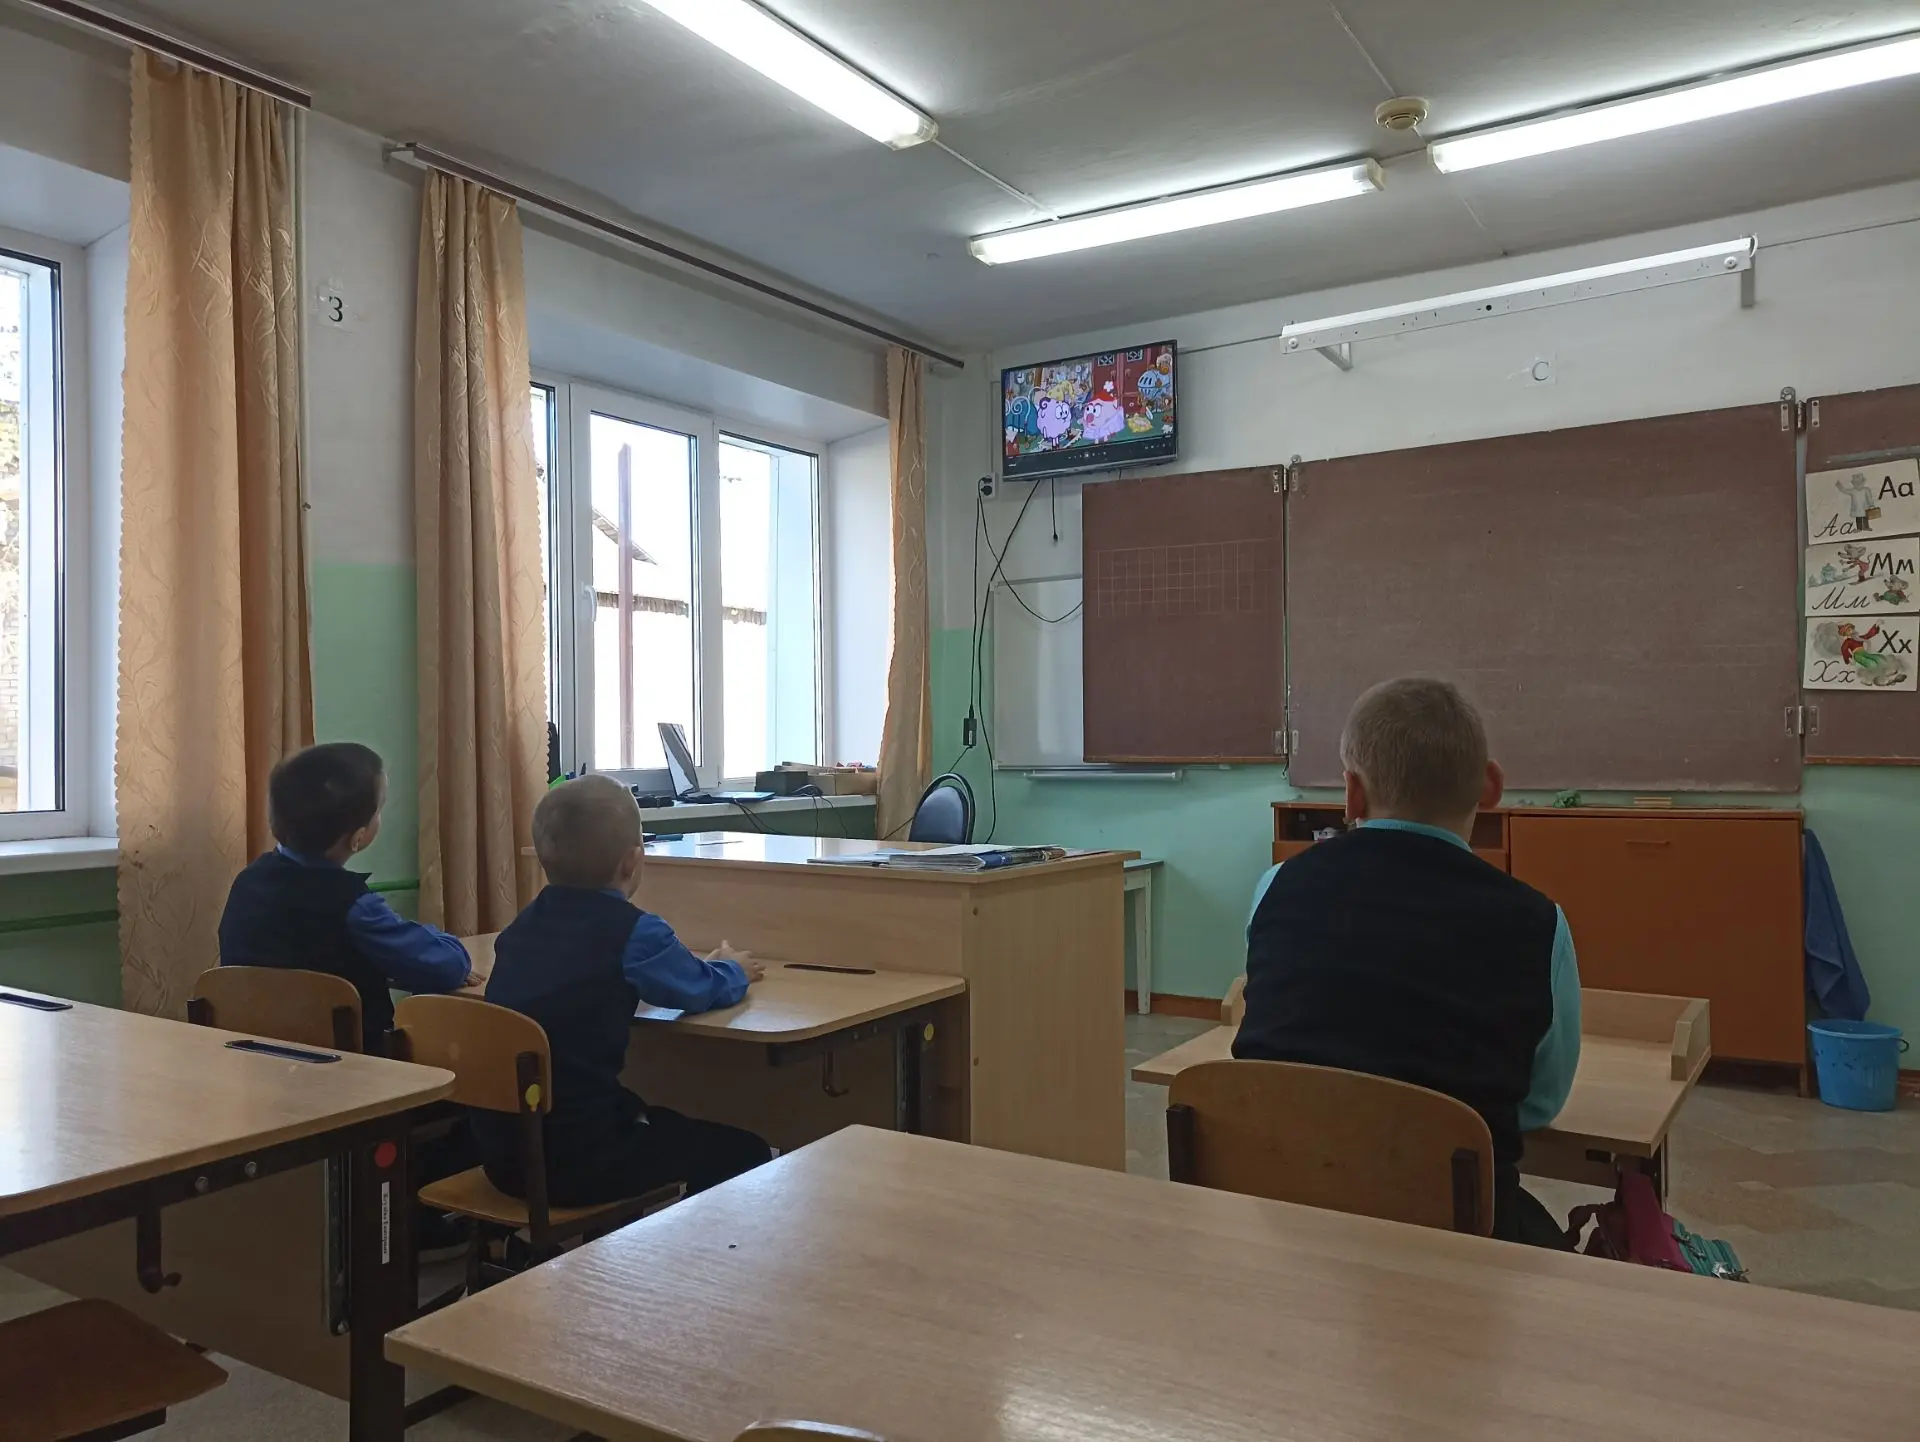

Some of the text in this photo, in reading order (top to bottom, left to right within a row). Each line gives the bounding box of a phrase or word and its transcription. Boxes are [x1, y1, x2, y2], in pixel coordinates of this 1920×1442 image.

[1878, 475, 1915, 500] Аа
[1813, 513, 1855, 538] Аа
[1870, 552, 1915, 577] Мм
[1812, 586, 1870, 610] Мм
[1878, 629, 1913, 654] Хх
[1809, 660, 1855, 683] Хх
